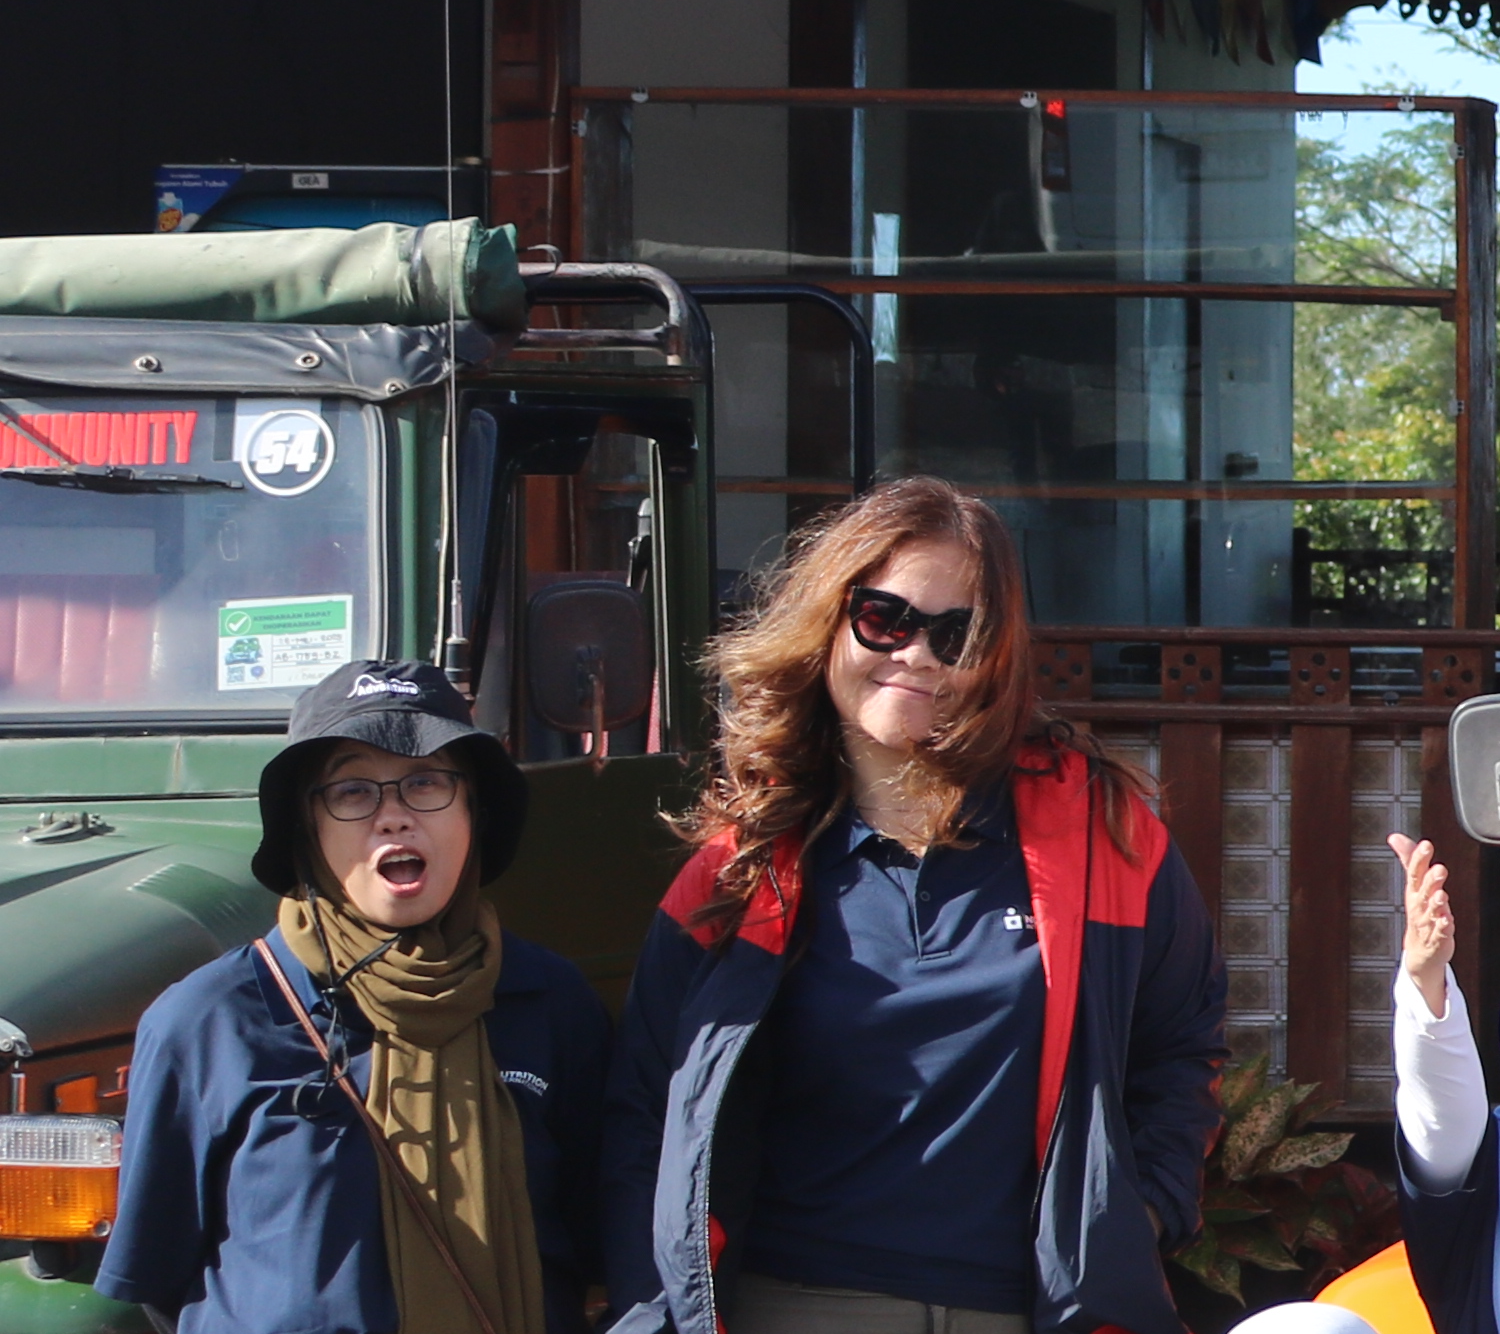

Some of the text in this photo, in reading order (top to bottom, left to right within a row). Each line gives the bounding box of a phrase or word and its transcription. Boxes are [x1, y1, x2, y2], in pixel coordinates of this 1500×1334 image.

[0, 410, 197, 468] OMMUNITY
[256, 429, 319, 475] 54
[500, 1070, 549, 1091] UTRITION
